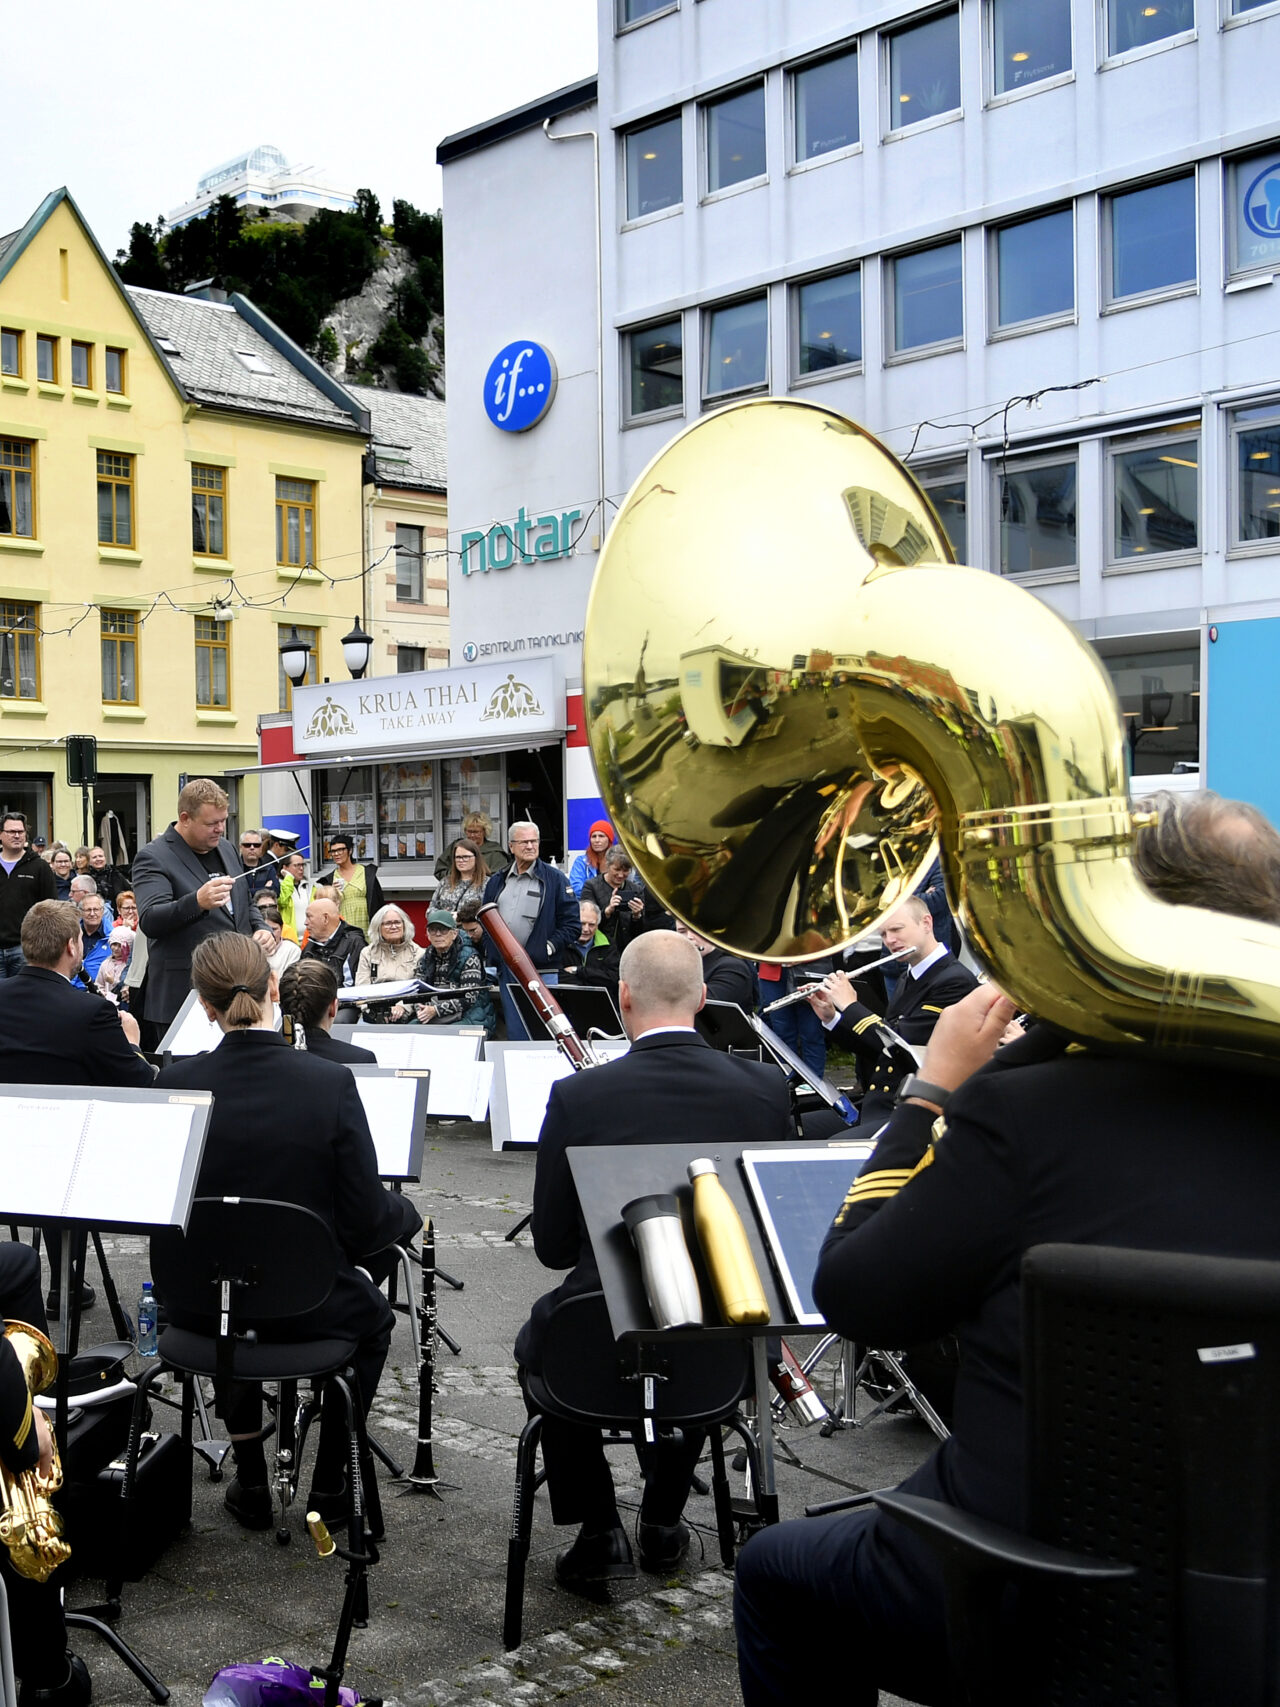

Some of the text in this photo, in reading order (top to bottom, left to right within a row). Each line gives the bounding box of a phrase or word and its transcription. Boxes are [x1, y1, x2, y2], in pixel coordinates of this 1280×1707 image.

[1250, 241, 1280, 257] 701
[461, 506, 583, 576] notar
[479, 638, 526, 656] SENTRUM
[358, 682, 480, 715] KRUA THAI
[380, 710, 456, 730] TAKE AWAY
